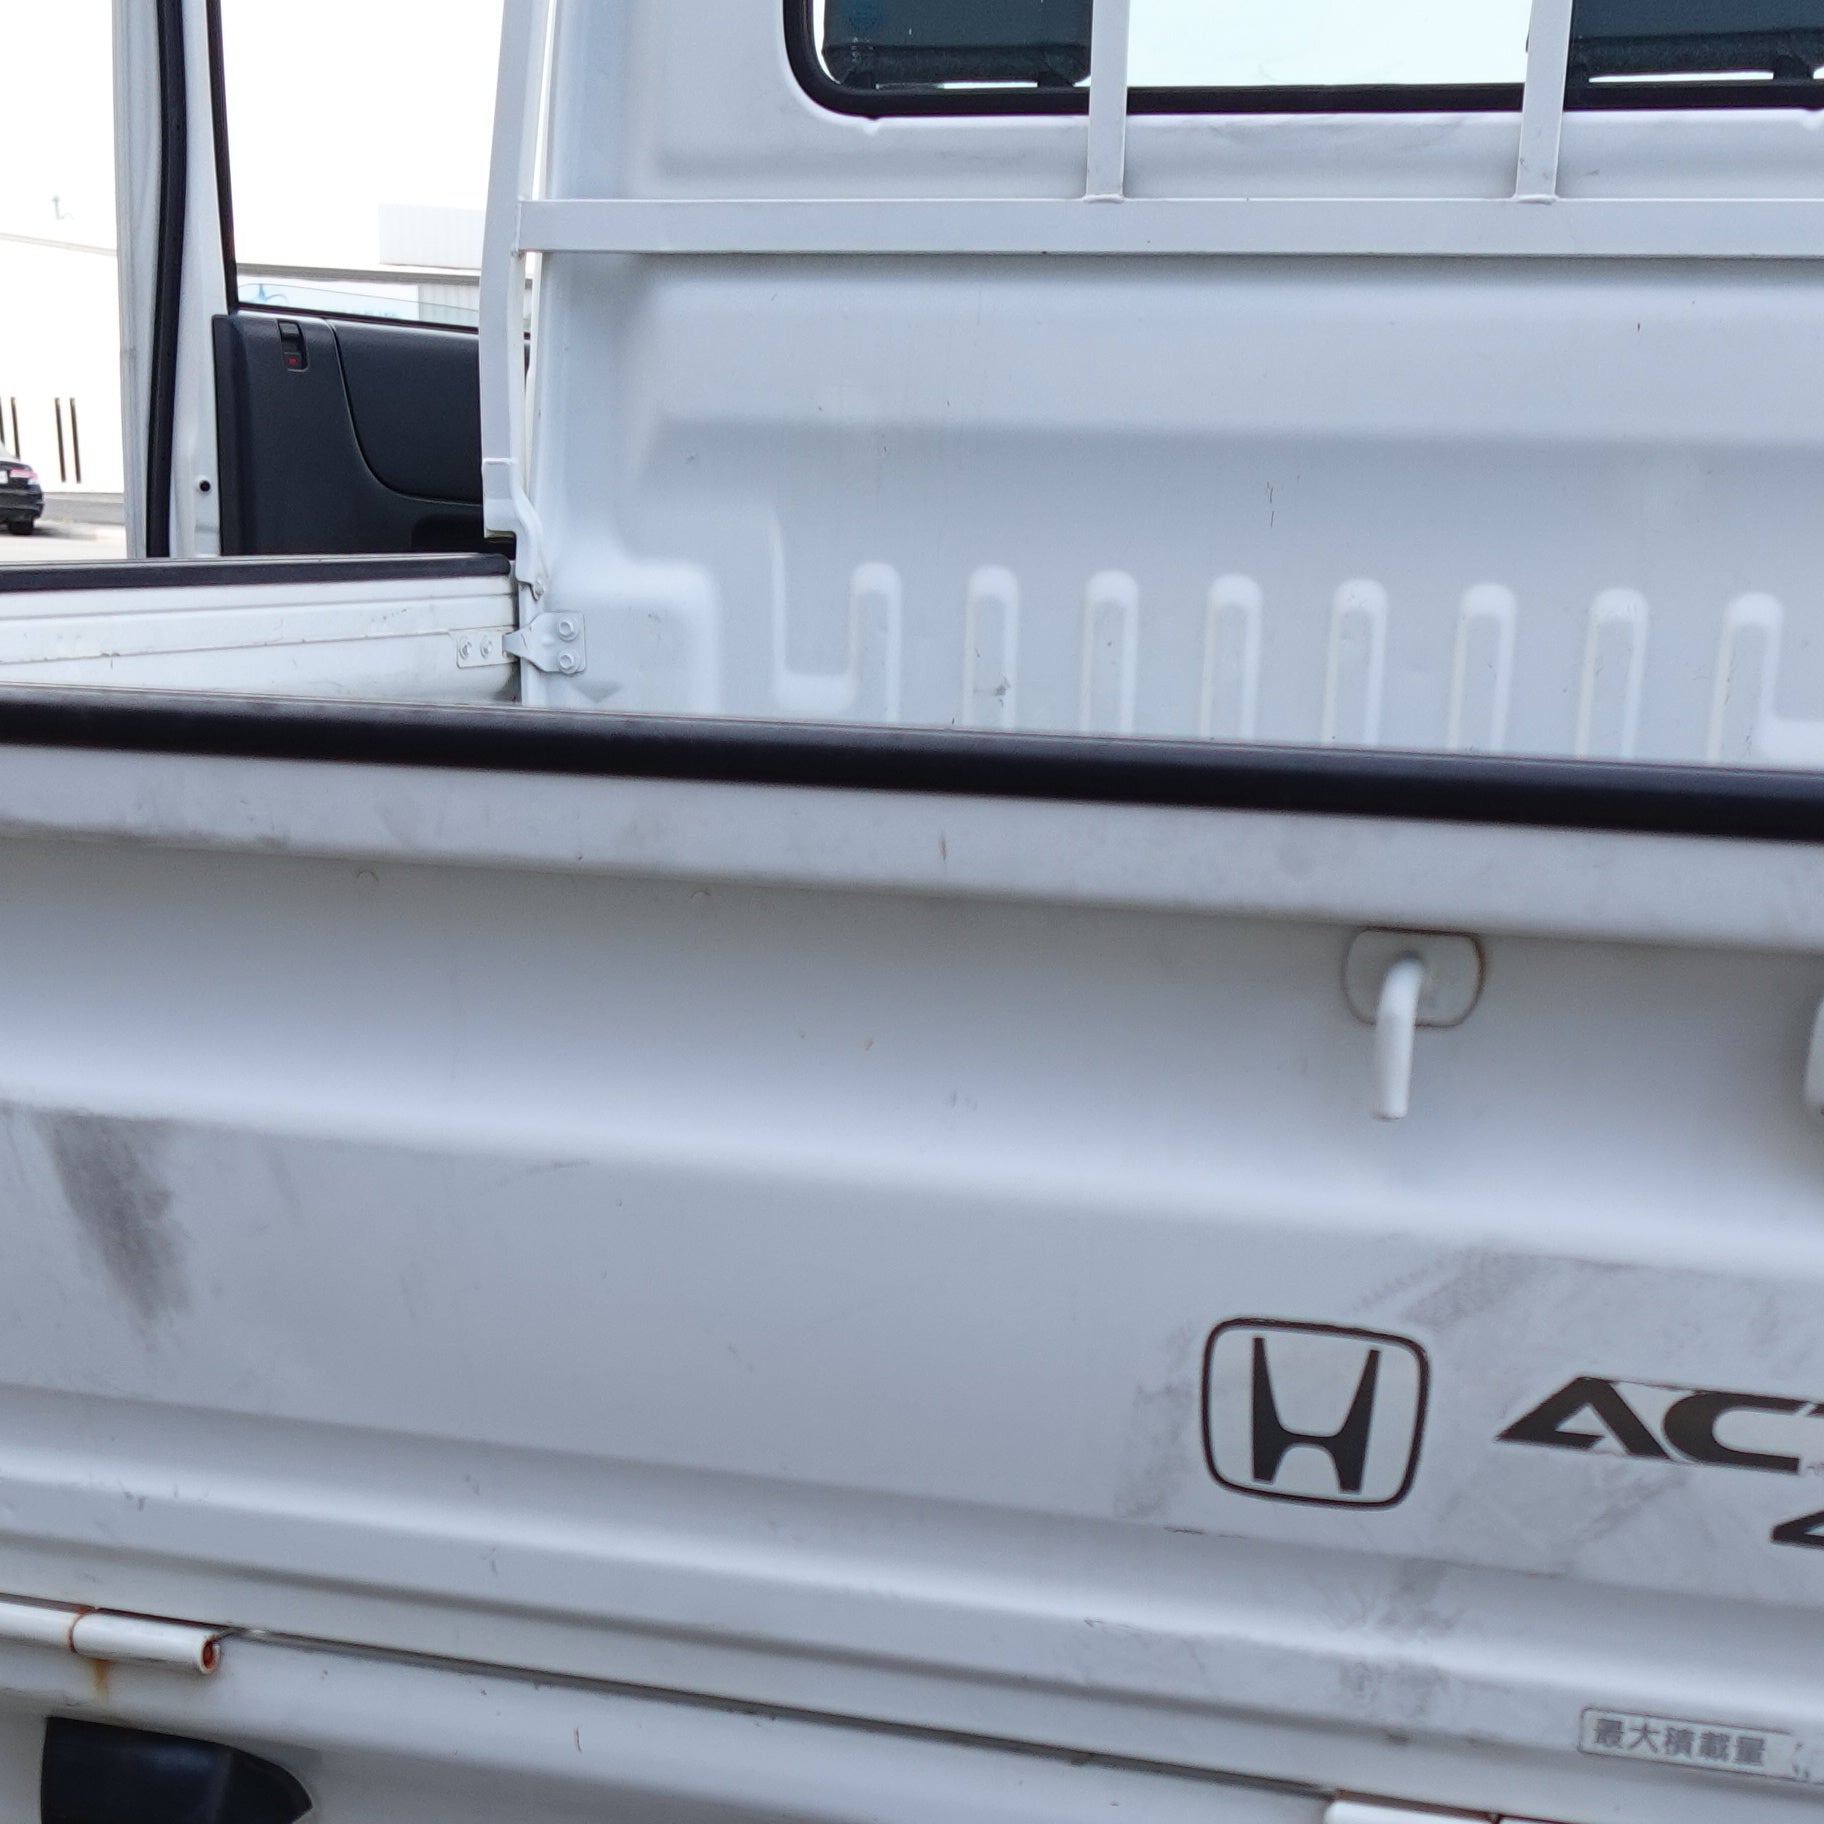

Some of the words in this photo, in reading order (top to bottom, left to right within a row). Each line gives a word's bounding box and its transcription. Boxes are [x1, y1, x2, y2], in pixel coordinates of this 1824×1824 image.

[1592, 1717, 1767, 1767] 最大積載量
